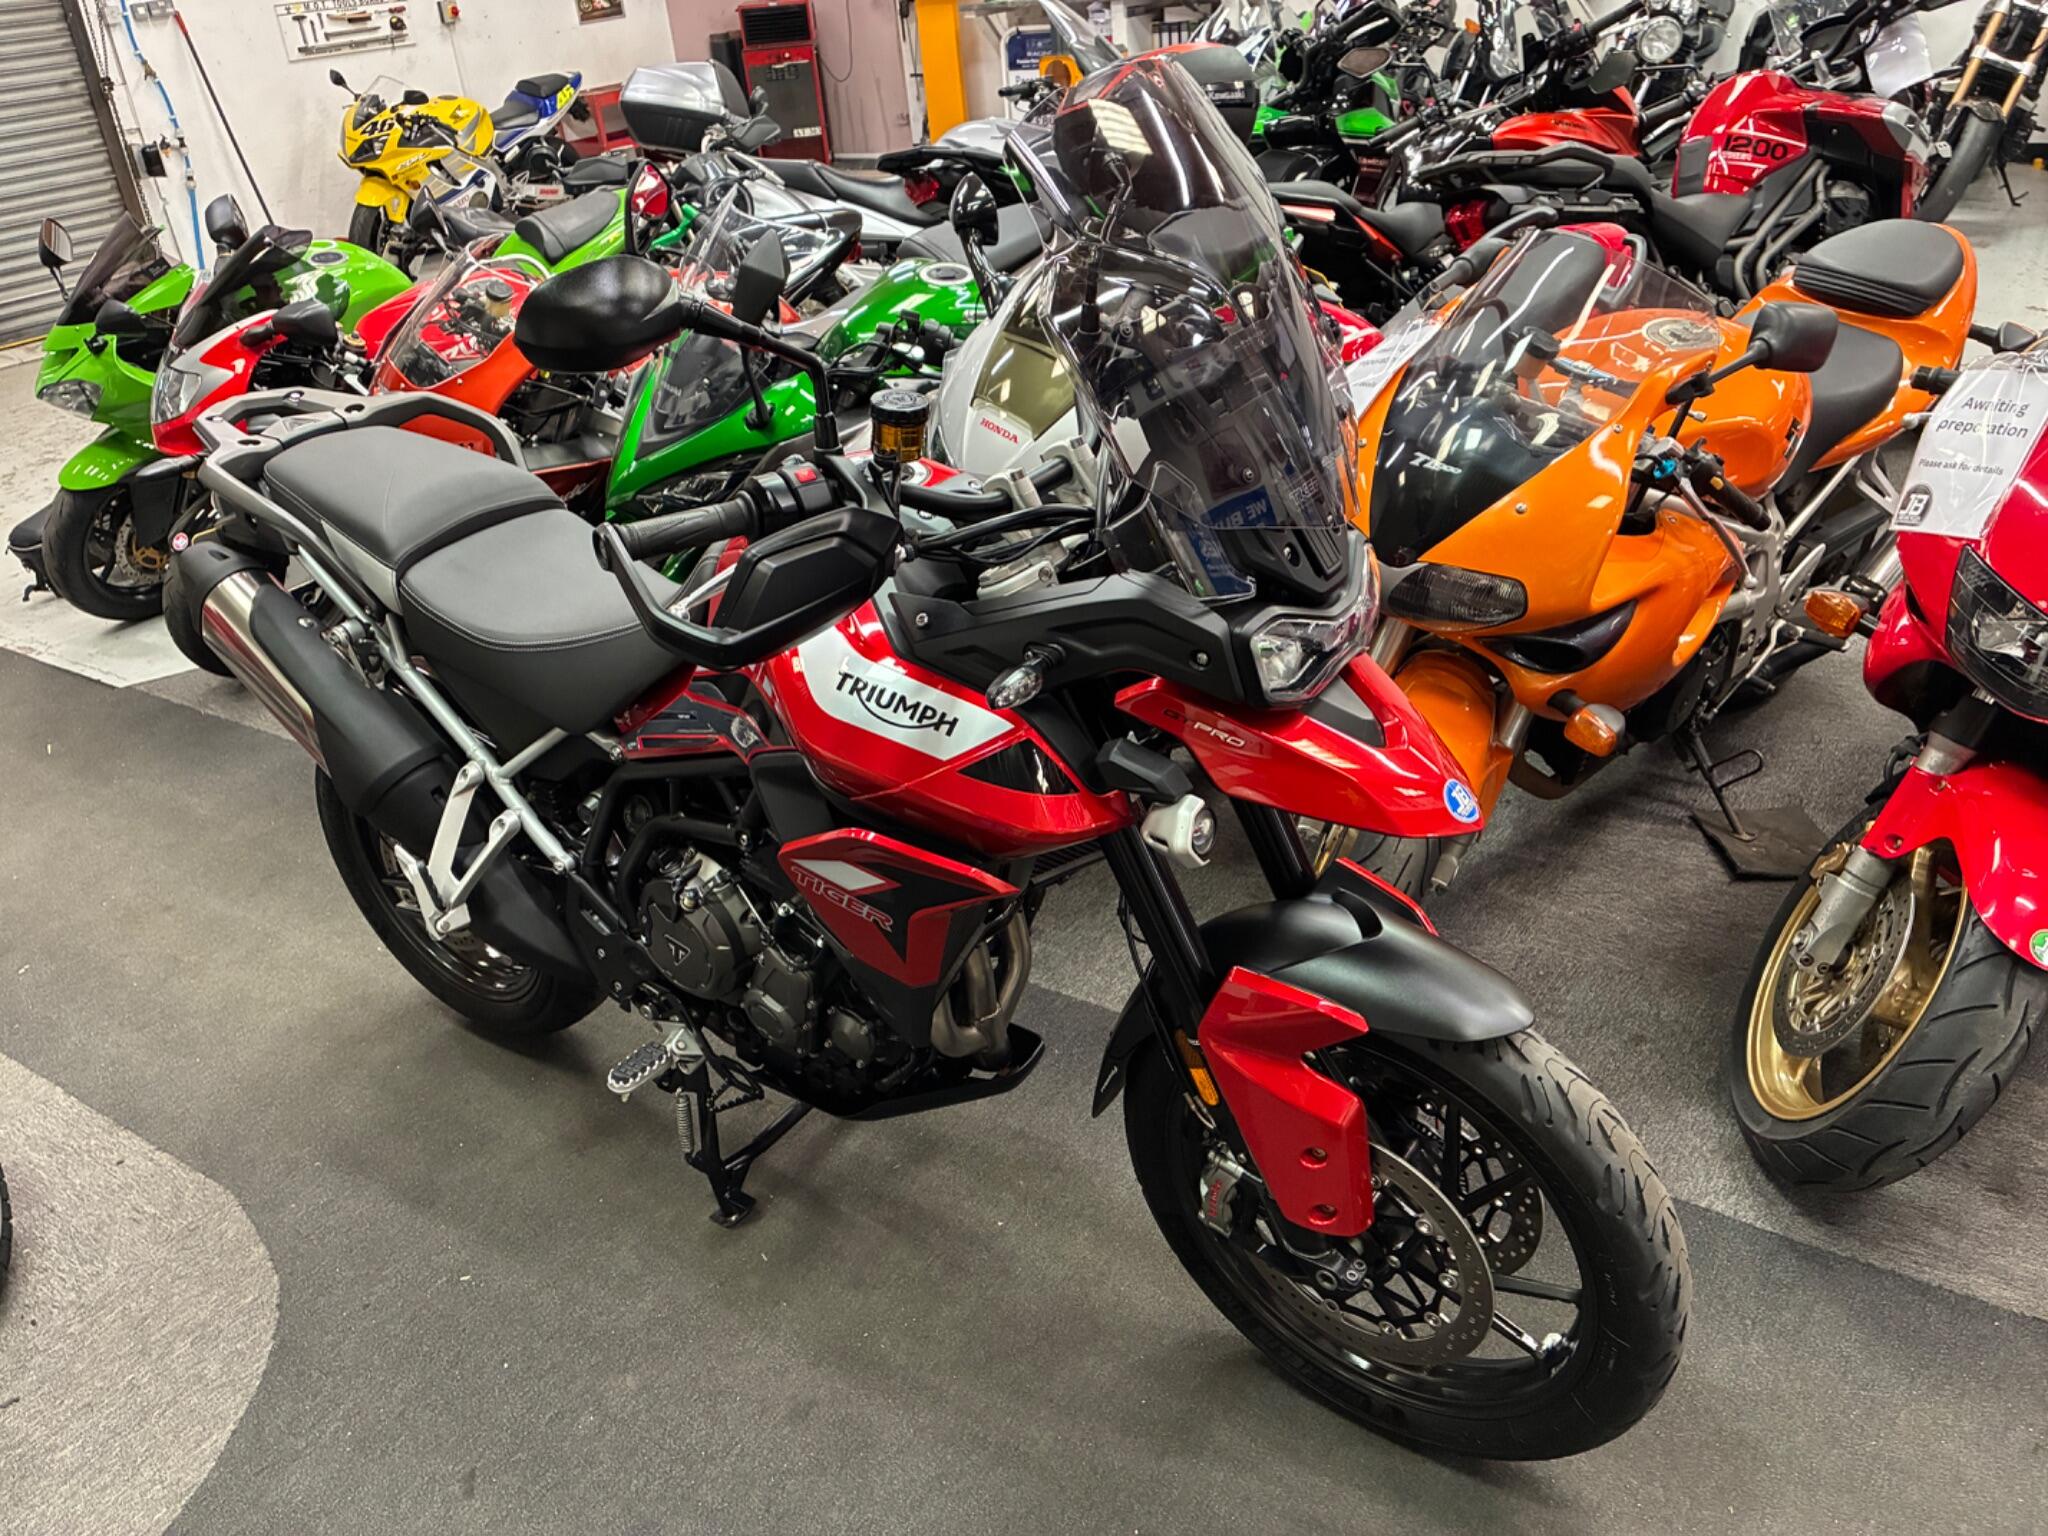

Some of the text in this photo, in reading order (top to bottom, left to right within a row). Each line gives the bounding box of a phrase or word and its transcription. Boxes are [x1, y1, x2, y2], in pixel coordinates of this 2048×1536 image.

[361, 117, 395, 137] 46
[1723, 133, 1788, 161] 1200
[980, 417, 1018, 444] HONDA
[1936, 418, 2029, 438] prepaation
[1919, 458, 1941, 468] Please
[1943, 460, 1957, 469] ask
[836, 670, 960, 738] TRIUMPH
[1193, 721, 1246, 747] PRO
[791, 864, 894, 933] TIGER
